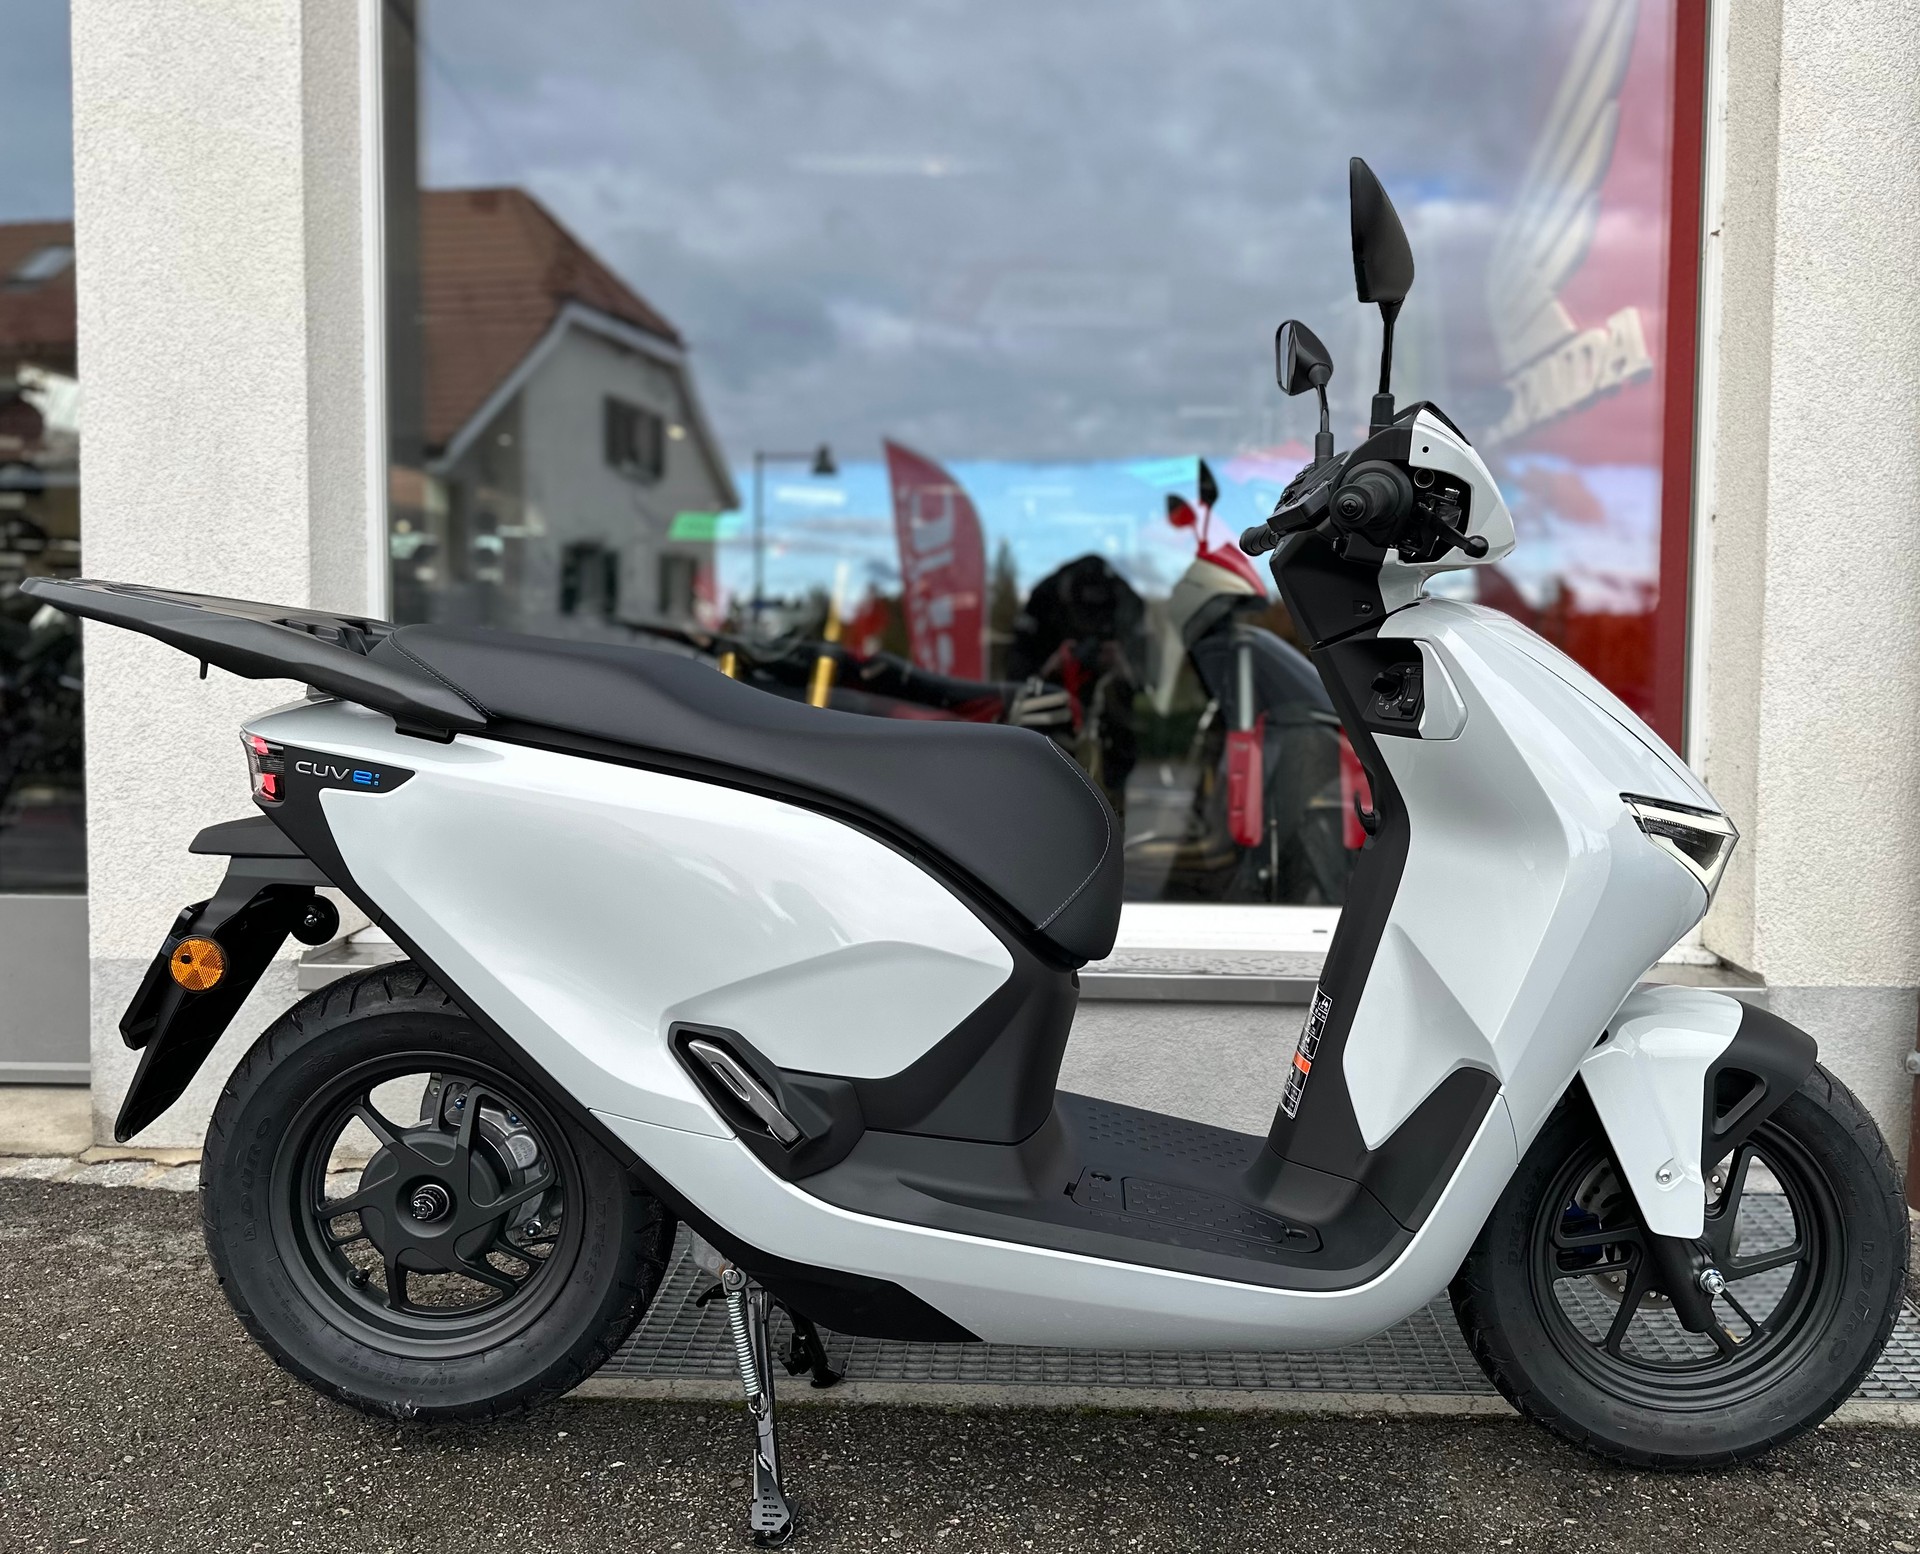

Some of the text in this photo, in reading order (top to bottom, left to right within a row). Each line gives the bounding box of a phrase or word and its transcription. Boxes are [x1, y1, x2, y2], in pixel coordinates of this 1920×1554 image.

[295, 761, 381, 786] CUV e:
[240, 1115, 272, 1219] DURO
[1827, 1261, 1876, 1364] DURO
